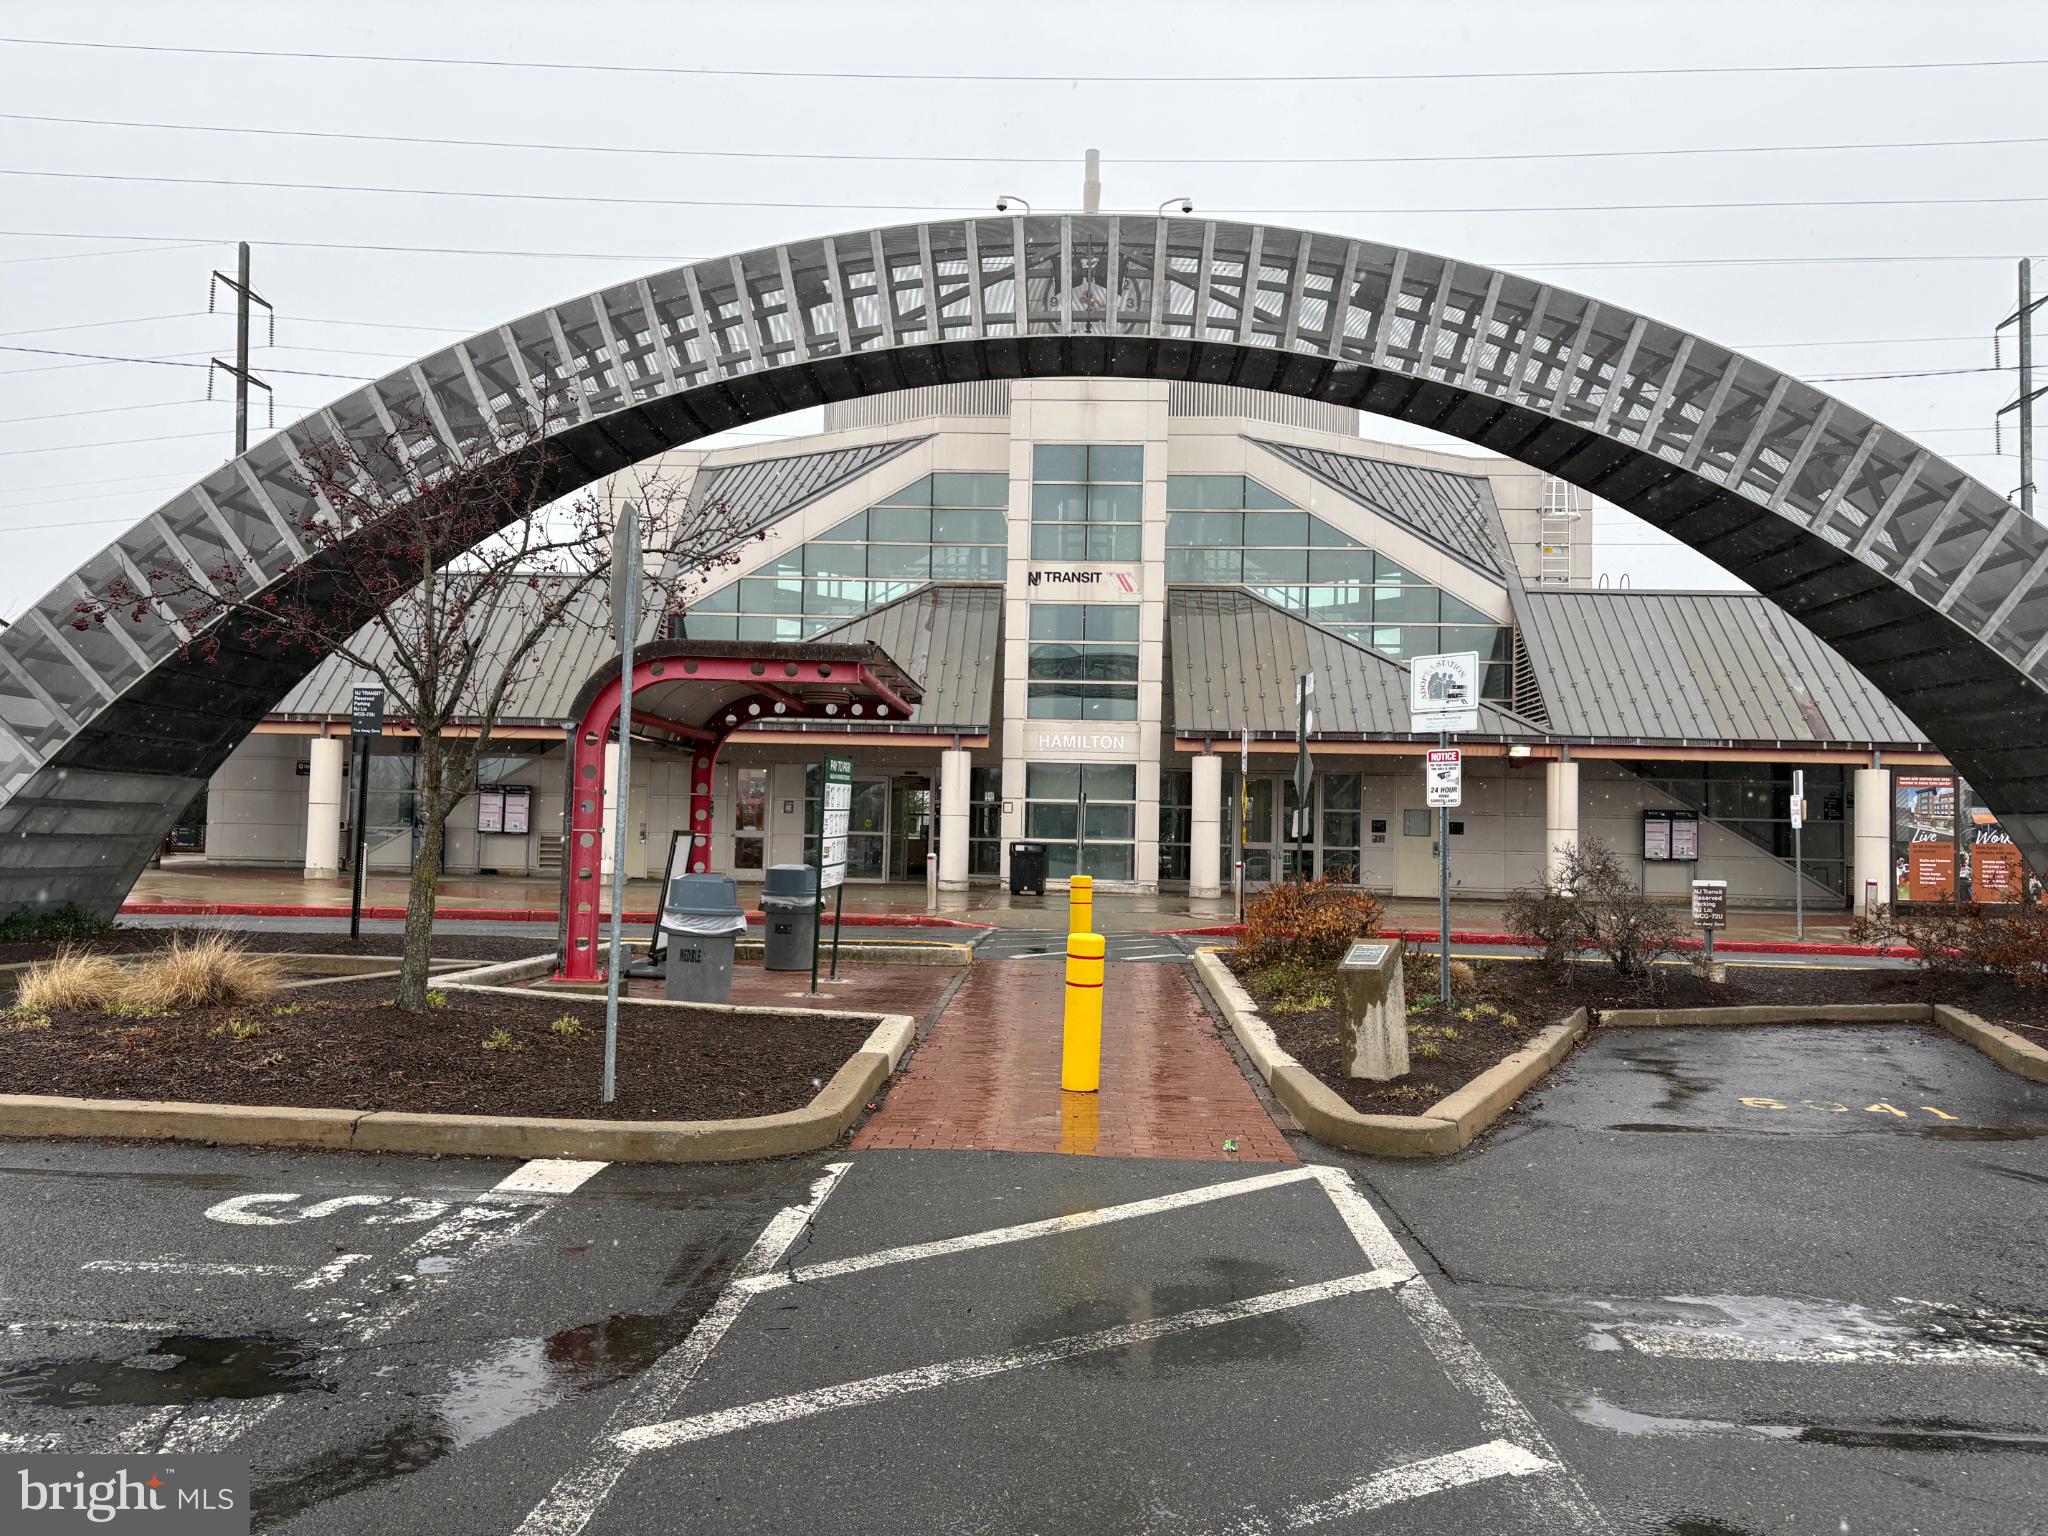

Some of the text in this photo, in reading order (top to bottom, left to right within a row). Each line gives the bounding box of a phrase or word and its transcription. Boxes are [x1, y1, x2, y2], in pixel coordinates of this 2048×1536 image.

[1028, 571, 1103, 586] NJ TRANSIT
[1039, 734, 1124, 749] HAMILTON
[1431, 751, 1457, 761] NOTICE
[1911, 828, 1937, 843] Live
